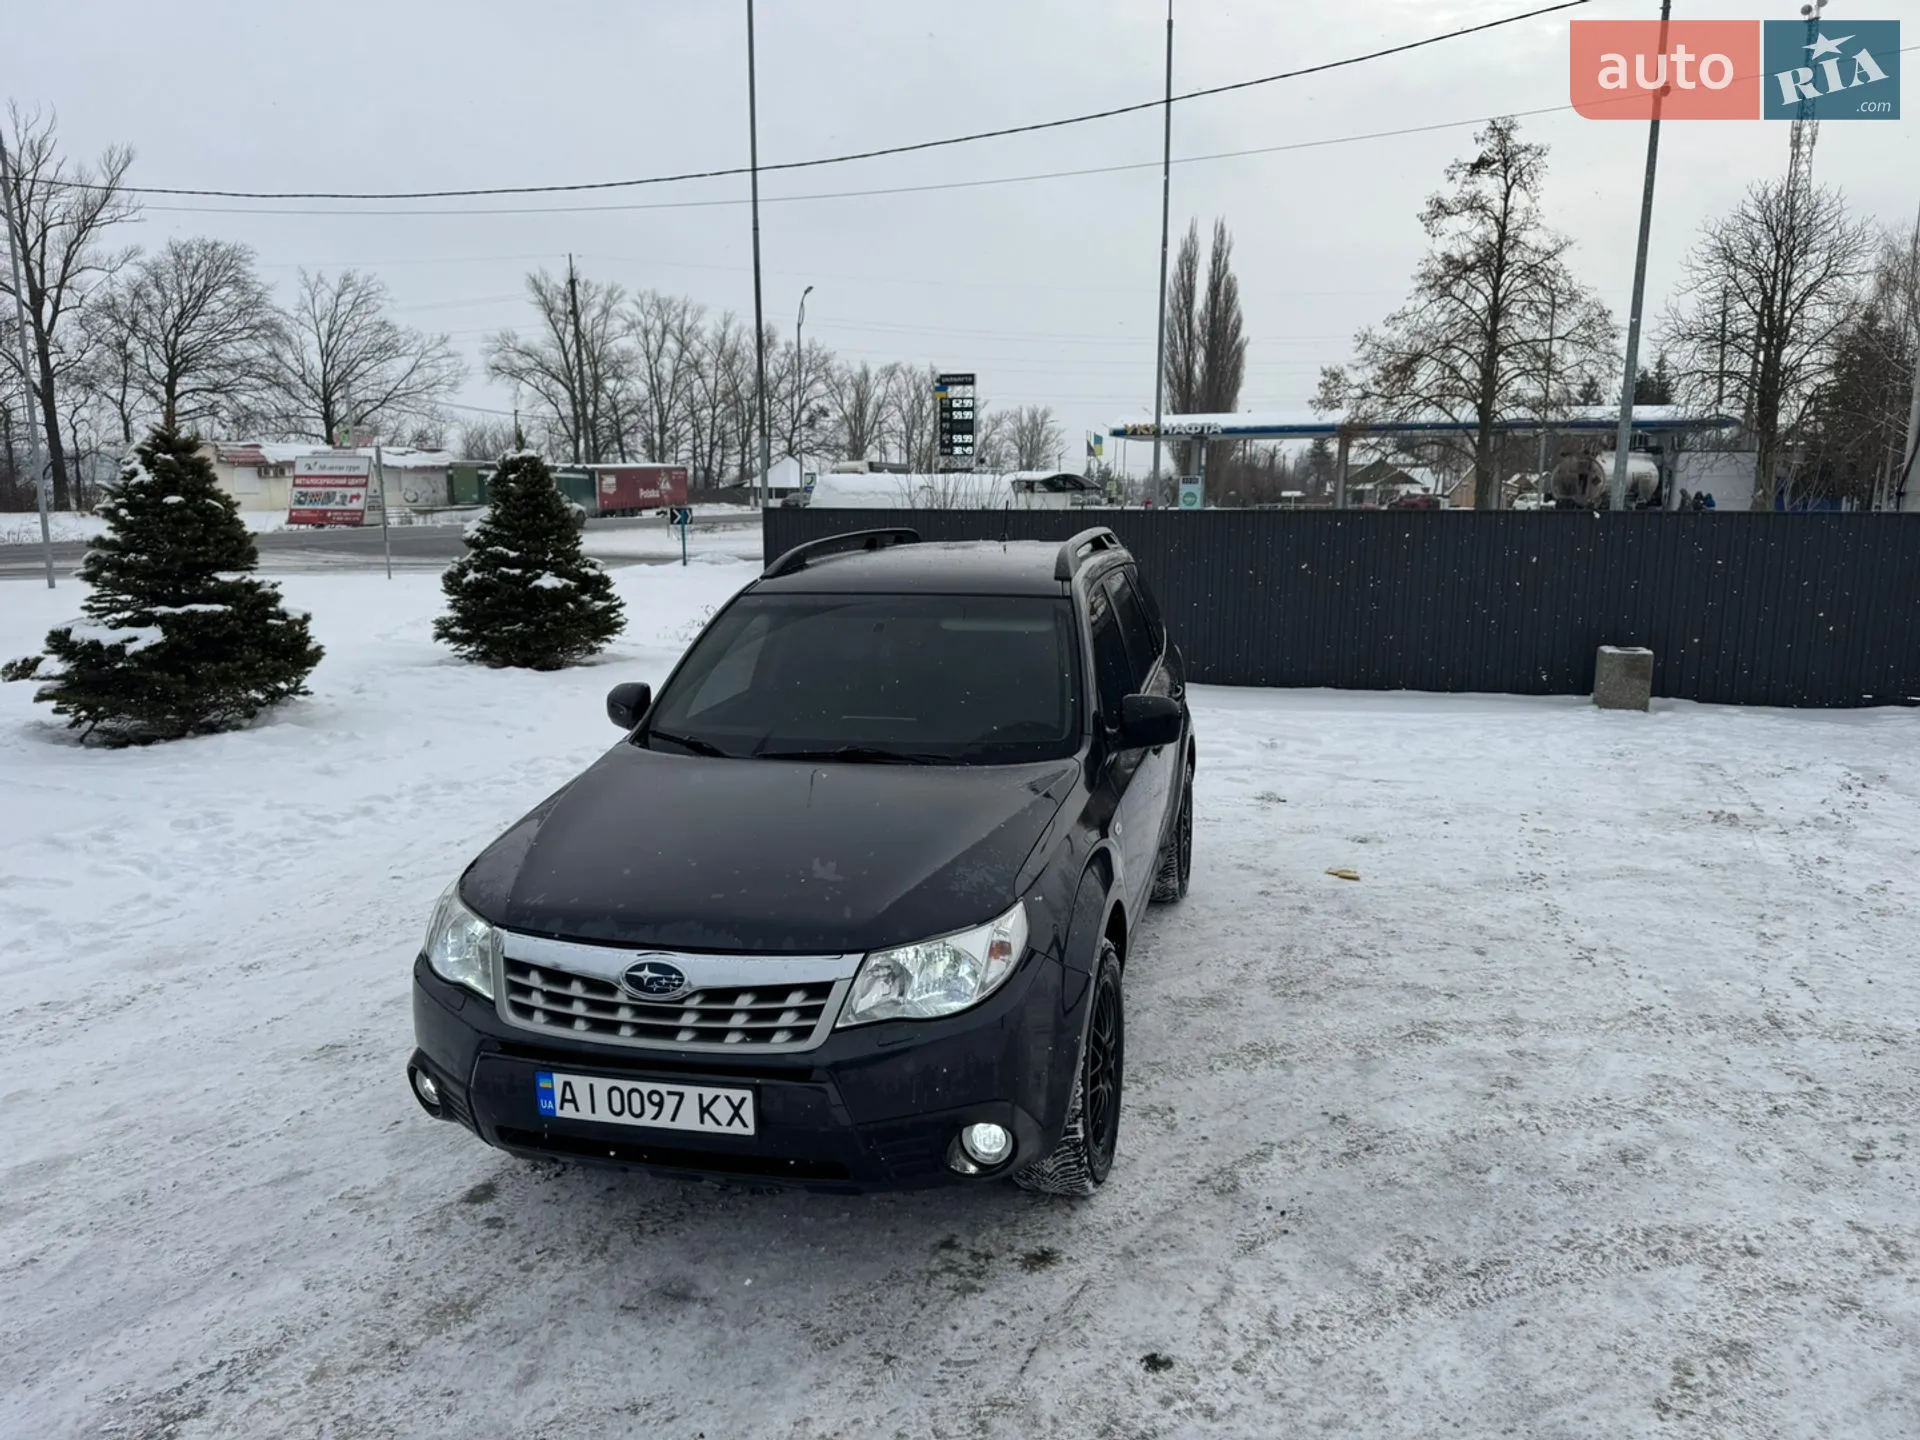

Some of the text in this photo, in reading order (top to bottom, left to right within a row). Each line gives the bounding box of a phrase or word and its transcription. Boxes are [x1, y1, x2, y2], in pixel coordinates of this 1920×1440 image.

[952, 399, 973, 408] 62.99
[952, 411, 973, 420] 59.99
[952, 434, 973, 443] 59.99
[952, 446, 973, 455] 38.49
[540, 1099, 554, 1110] UA
[607, 1085, 685, 1122] 0097
[698, 1093, 749, 1128] KX
